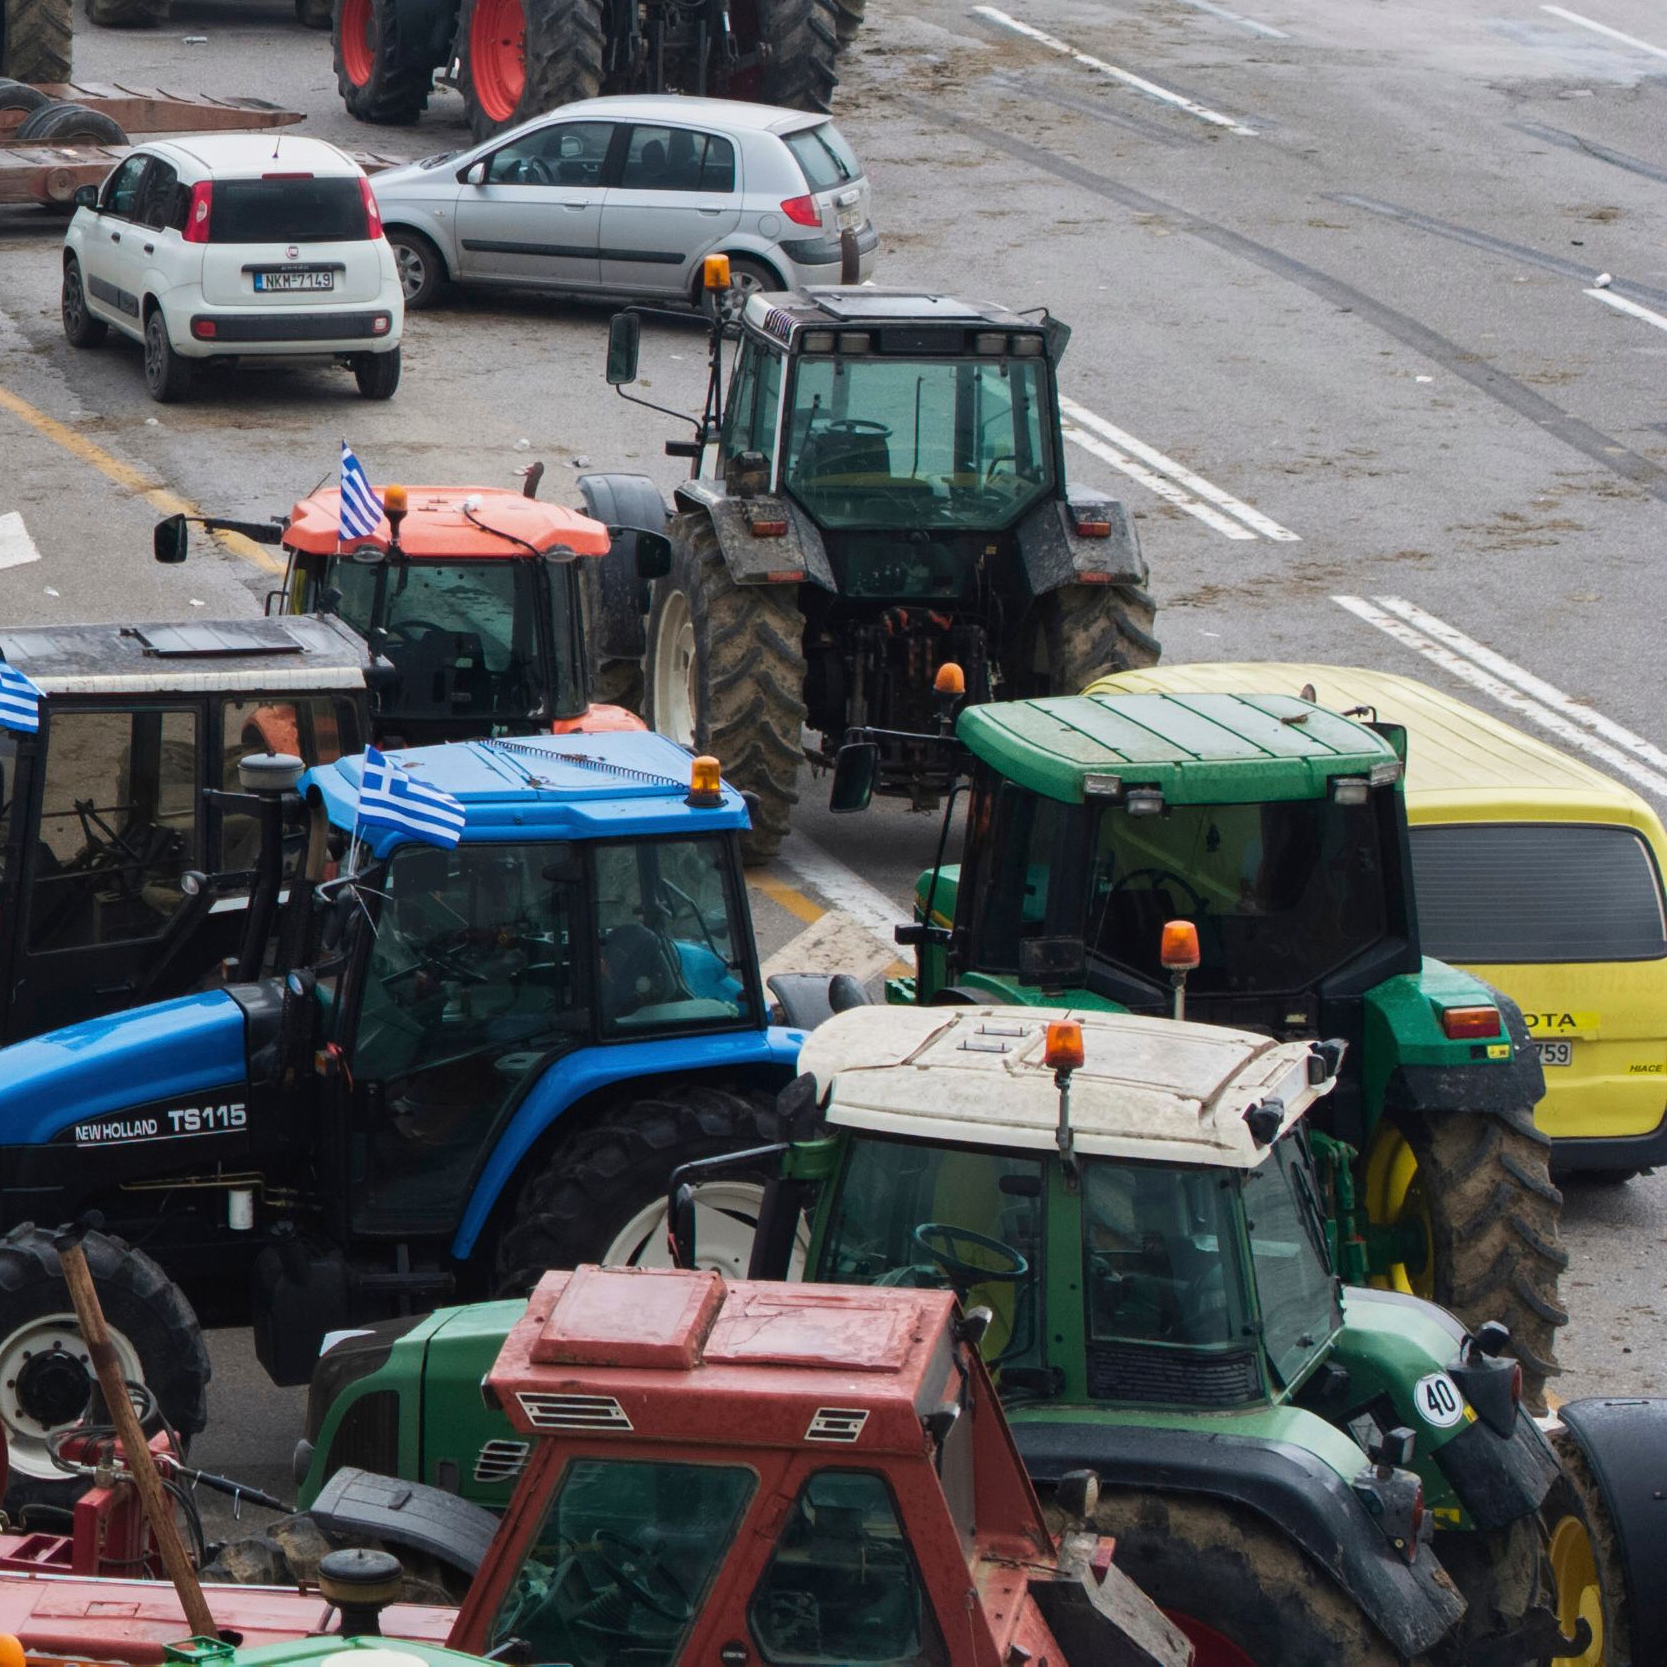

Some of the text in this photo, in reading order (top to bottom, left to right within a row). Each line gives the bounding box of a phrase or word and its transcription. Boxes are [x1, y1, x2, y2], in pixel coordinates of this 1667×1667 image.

[1524, 1013, 1577, 1029] OTA
[1629, 1064, 1663, 1074] HIACE
[75, 1103, 248, 1140] NEW HOLLAND TS115
[1426, 1380, 1456, 1417] 40
